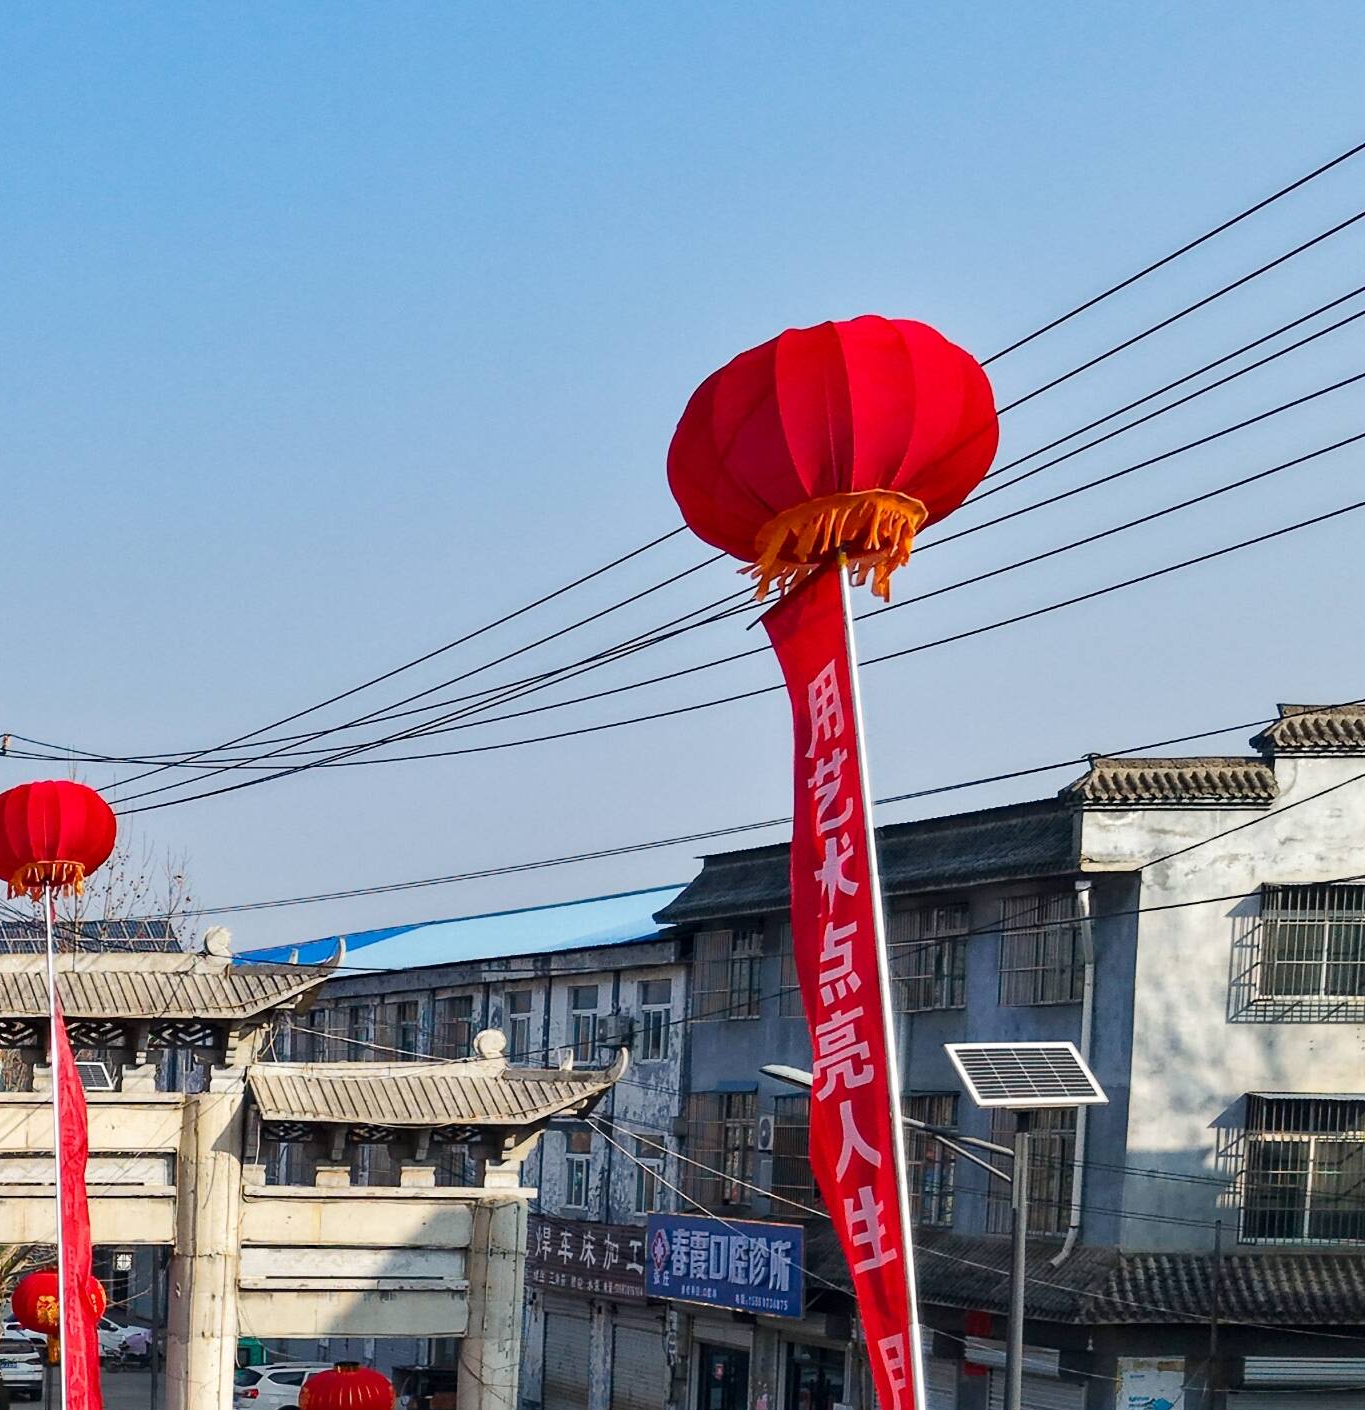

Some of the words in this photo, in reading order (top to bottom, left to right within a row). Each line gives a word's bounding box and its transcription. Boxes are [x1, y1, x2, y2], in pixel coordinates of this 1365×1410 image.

[805, 659, 898, 1276] 用艺术点亮人生
[526, 1226, 644, 1274] 焊车床加工
[671, 1229, 792, 1291] 春霞口腔诊所
